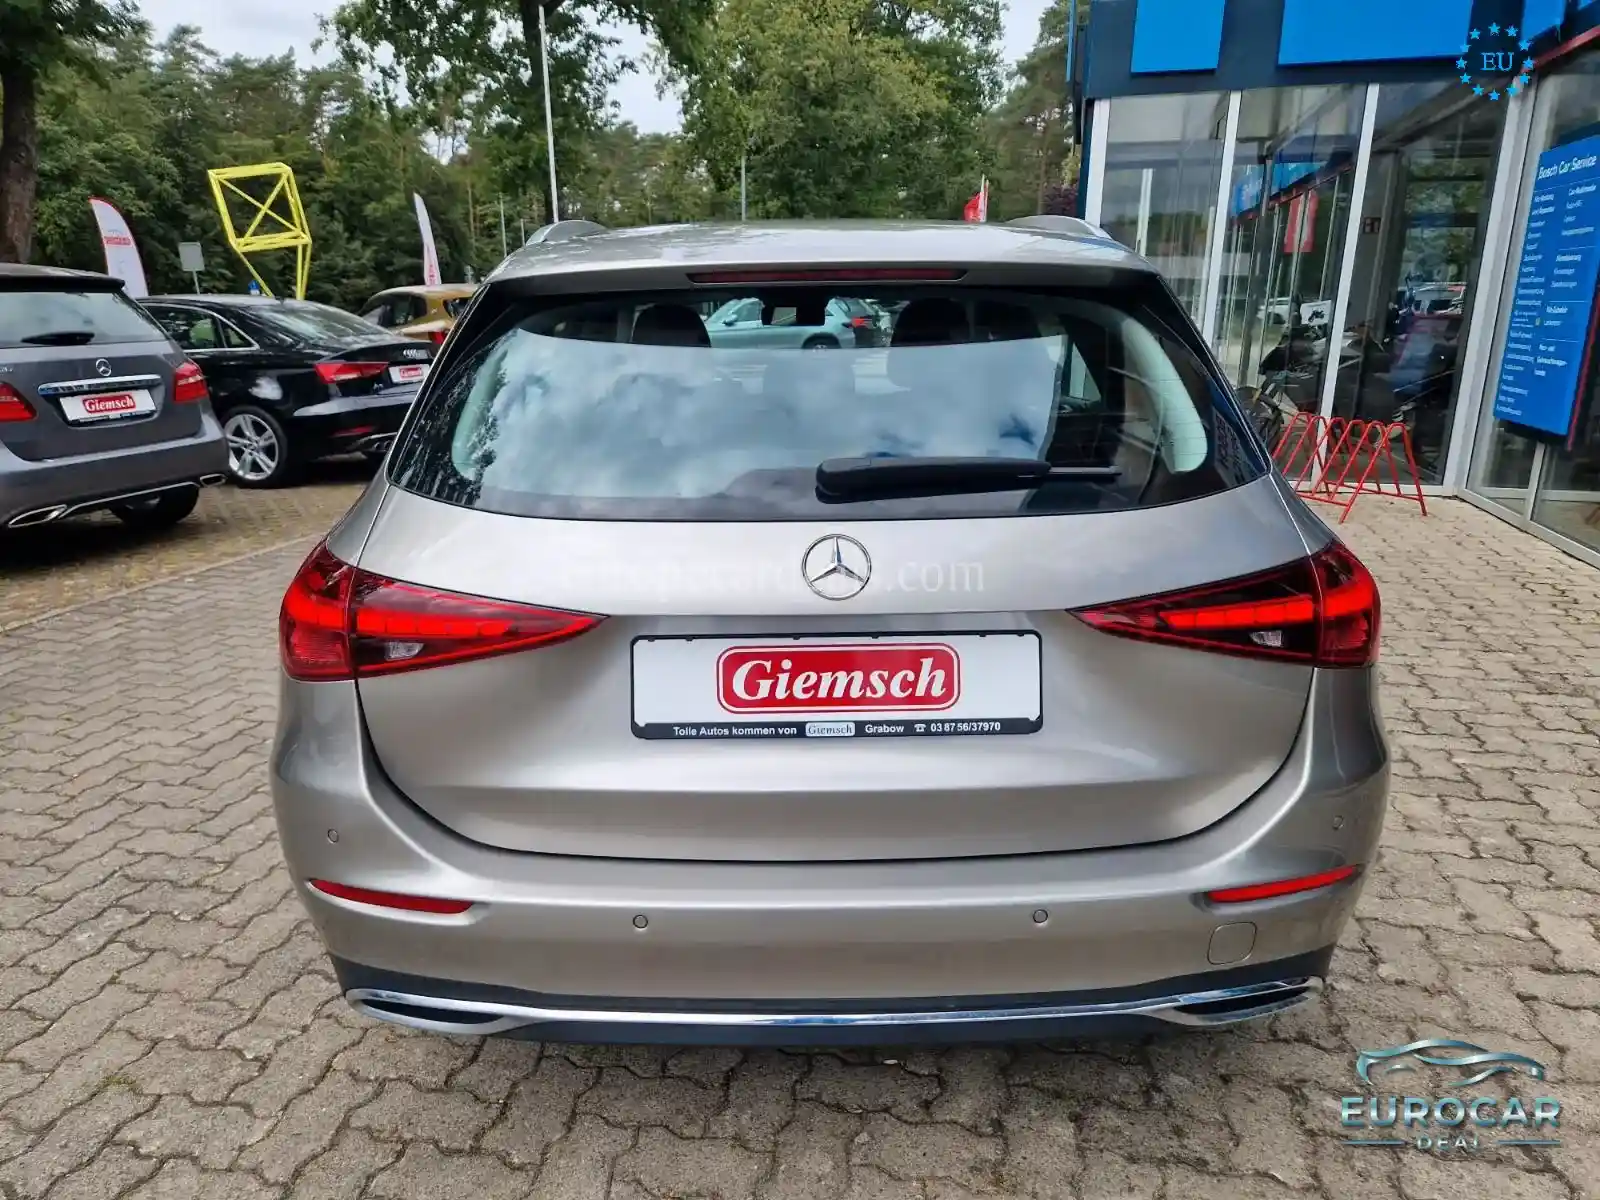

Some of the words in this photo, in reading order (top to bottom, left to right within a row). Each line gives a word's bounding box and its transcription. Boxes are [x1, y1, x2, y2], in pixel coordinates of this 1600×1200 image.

[1538, 164, 1557, 180] Bosch
[1559, 160, 1571, 174] Car
[1572, 154, 1597, 170] Service
[85, 396, 134, 411] Giemsch
[732, 657, 947, 700] Giemsch
[673, 726, 697, 736] Tolle
[699, 726, 729, 736] Autos
[732, 725, 775, 735] kommen
[808, 724, 853, 735] Giemsch
[865, 724, 904, 733] Grabow
